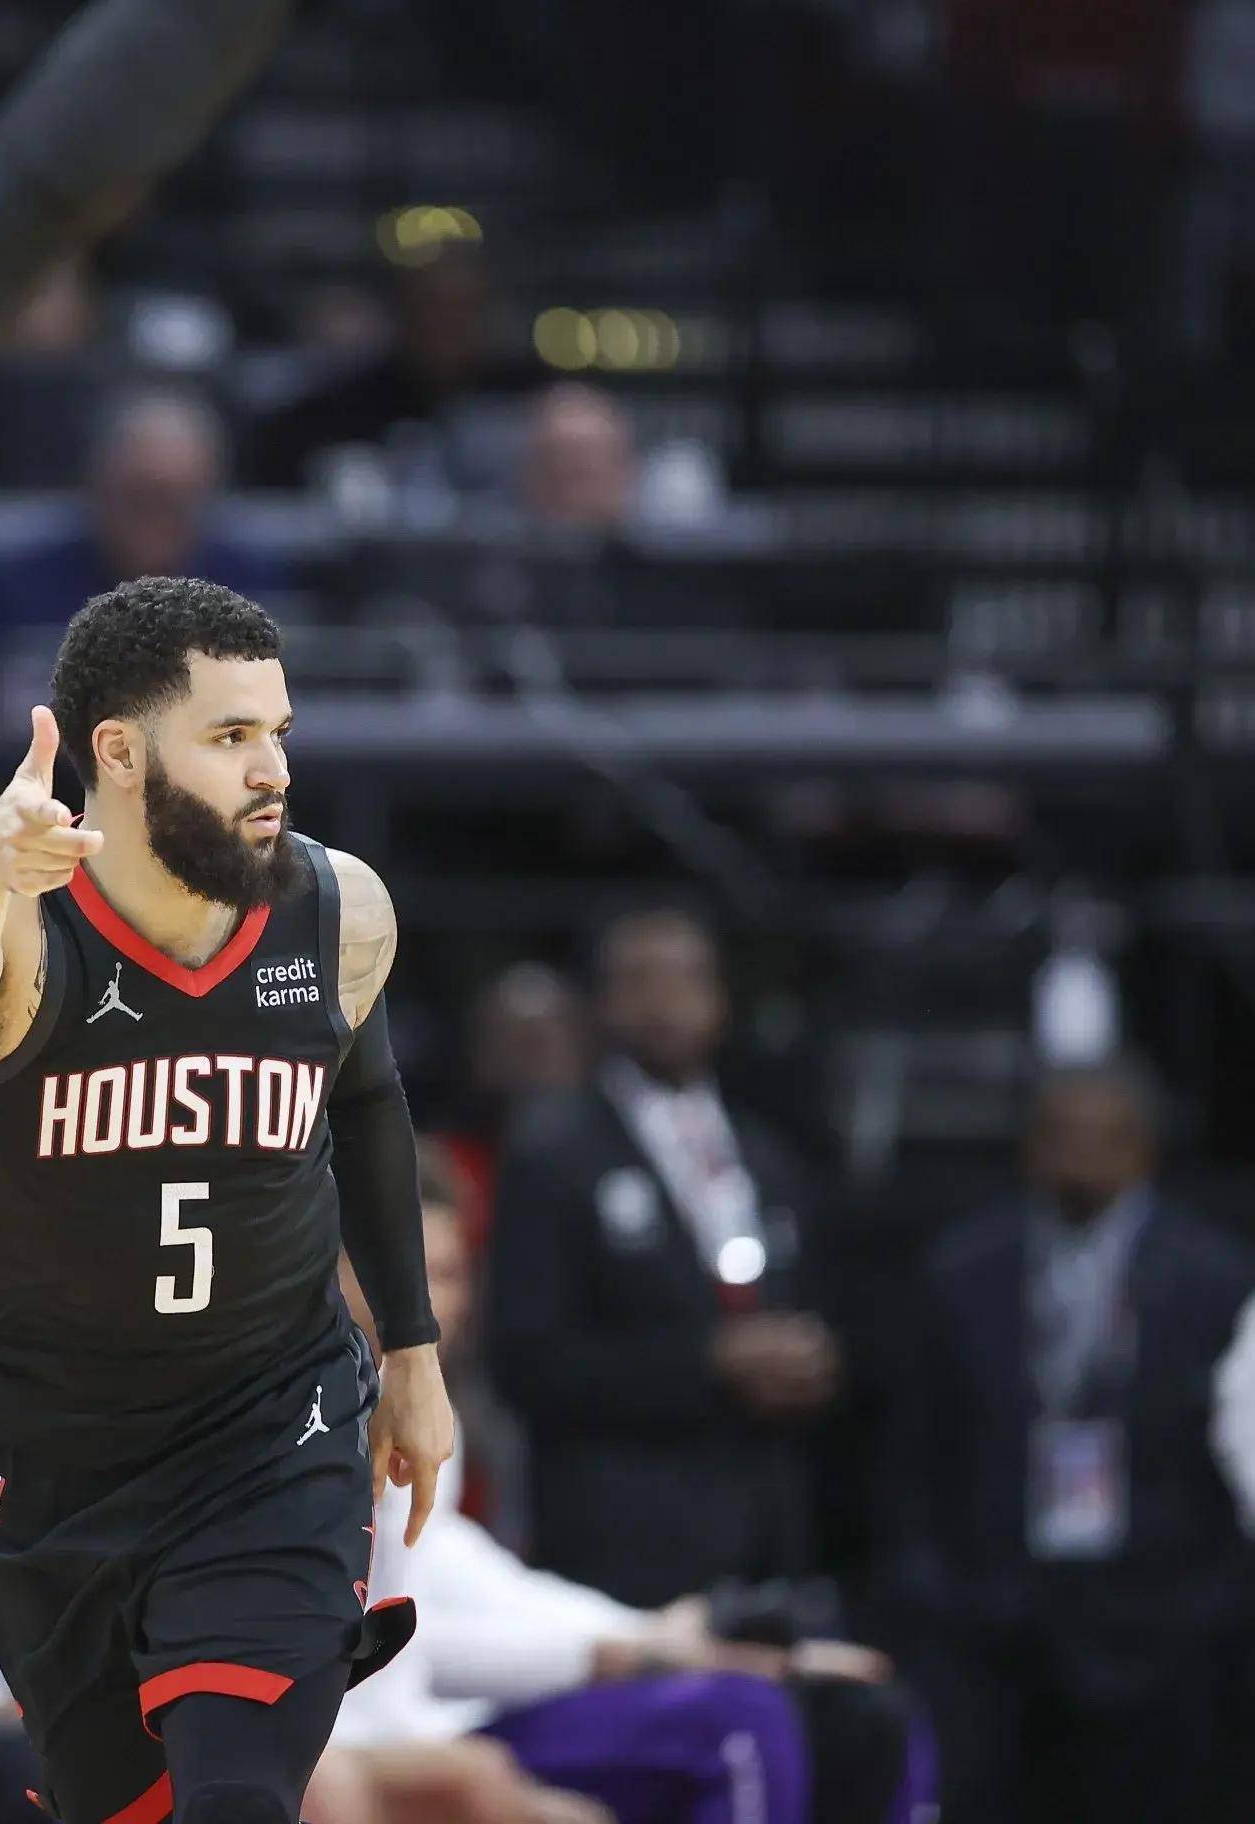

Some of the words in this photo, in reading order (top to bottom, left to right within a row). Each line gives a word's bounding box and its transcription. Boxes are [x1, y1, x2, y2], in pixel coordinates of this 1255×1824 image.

[255, 985, 320, 1008] karma
[256, 957, 317, 984] credit
[37, 1053, 325, 1158] HOUSTON
[154, 1182, 214, 1314] 5
